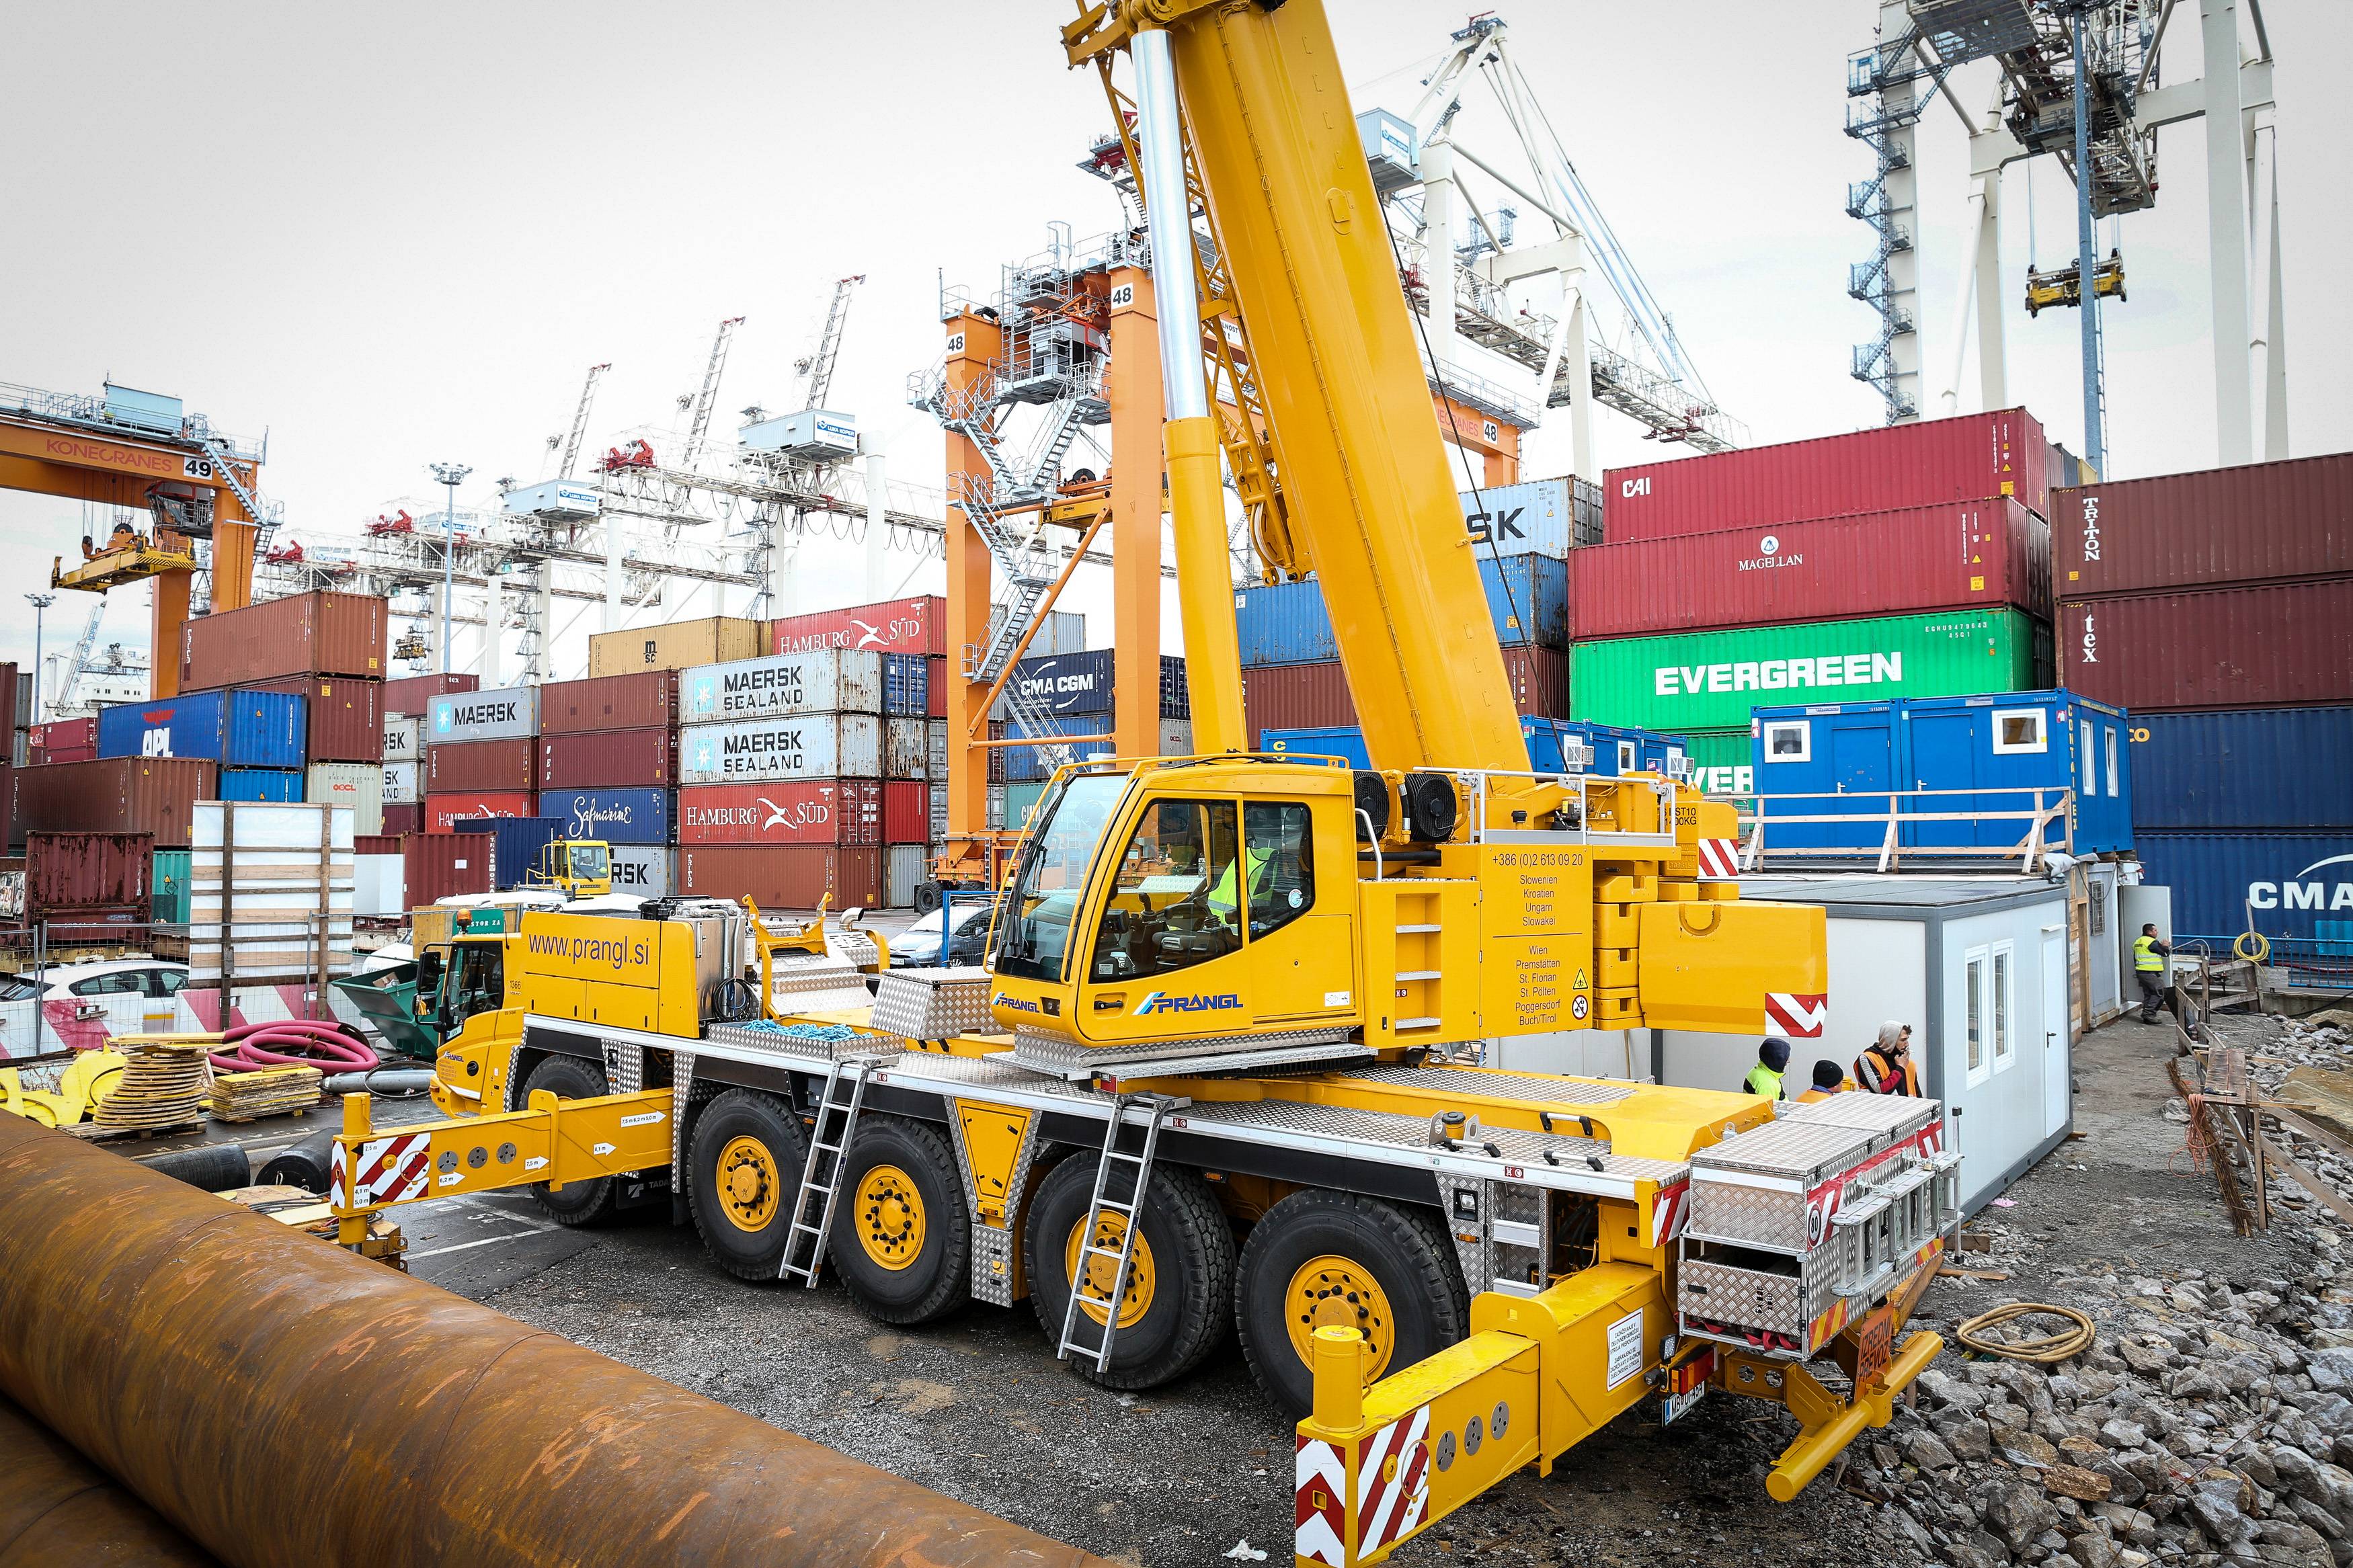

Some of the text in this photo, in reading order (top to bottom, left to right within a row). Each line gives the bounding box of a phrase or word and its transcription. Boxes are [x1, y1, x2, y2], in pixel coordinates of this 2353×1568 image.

[1113, 287, 1131, 304] 48
[948, 336, 963, 352] 48
[827, 425, 854, 437] LUKA KOPER
[1437, 408, 1479, 437] ECANES
[1484, 424, 1497, 442] 48
[46, 439, 172, 472] KONECRANES
[185, 460, 212, 477] 49
[1622, 477, 1650, 498] CAI
[581, 495, 596, 503] KOPER
[1466, 507, 1526, 545] SK
[2083, 497, 2101, 561] TRITON
[1739, 554, 1803, 572] MAGELLAN
[780, 617, 920, 655] HAMBURG SÜD
[2082, 614, 2100, 663] tex
[77, 657, 85, 673] PORT
[87, 620, 99, 641] KOPER
[724, 665, 803, 692] MAERSK
[1654, 651, 1903, 696] EVERGREEN
[1021, 673, 1094, 696] CMA CGM
[724, 689, 803, 711] SEALAND
[454, 702, 516, 726] MAERSK
[142, 727, 173, 757] APL
[724, 730, 803, 754] MAERSK
[724, 753, 803, 773] SEALAND
[2067, 704, 2077, 831] CONTAINEX
[383, 771, 399, 785] SK
[333, 784, 356, 792] OOCL
[569, 796, 632, 838] Safmarine
[686, 800, 828, 827] HAMBURG SÜD
[1492, 853, 1583, 868] +386 (0)2 613 09 20
[1519, 874, 1558, 885] Slowenien
[1523, 889, 1554, 899] Kroatien
[2249, 881, 2353, 911] CMA
[1525, 902, 1552, 915] Ungarn
[469, 919, 489, 927] STOR
[1522, 915, 1556, 927] Slowakei
[528, 934, 649, 970] www.prangl.si
[1529, 945, 1548, 955] Wien
[1516, 958, 1560, 970] Premstätten
[510, 980, 521, 990] 1366
[1519, 972, 1557, 983] St. Florian
[1520, 985, 1556, 997] St. Pölten
[998, 995, 1041, 1014] PRANGL
[1152, 993, 1244, 1014] PRANGL
[1515, 999, 1561, 1013] Poggersdorf
[1519, 1013, 1556, 1026] Buch/Tirol
[444, 1053, 464, 1063] PRANGL
[439, 1176, 447, 1184] 6,2
[354, 1187, 362, 1195] 4,1
[354, 1198, 362, 1206] 5,0
[1811, 1216, 1818, 1234] 80
[1621, 1333, 1640, 1349] PREPOVEDANO
[1862, 1315, 1891, 1360] IZREDNI
[1858, 1340, 1889, 1388] PREVOZ
[1671, 1397, 1681, 1417] MB
